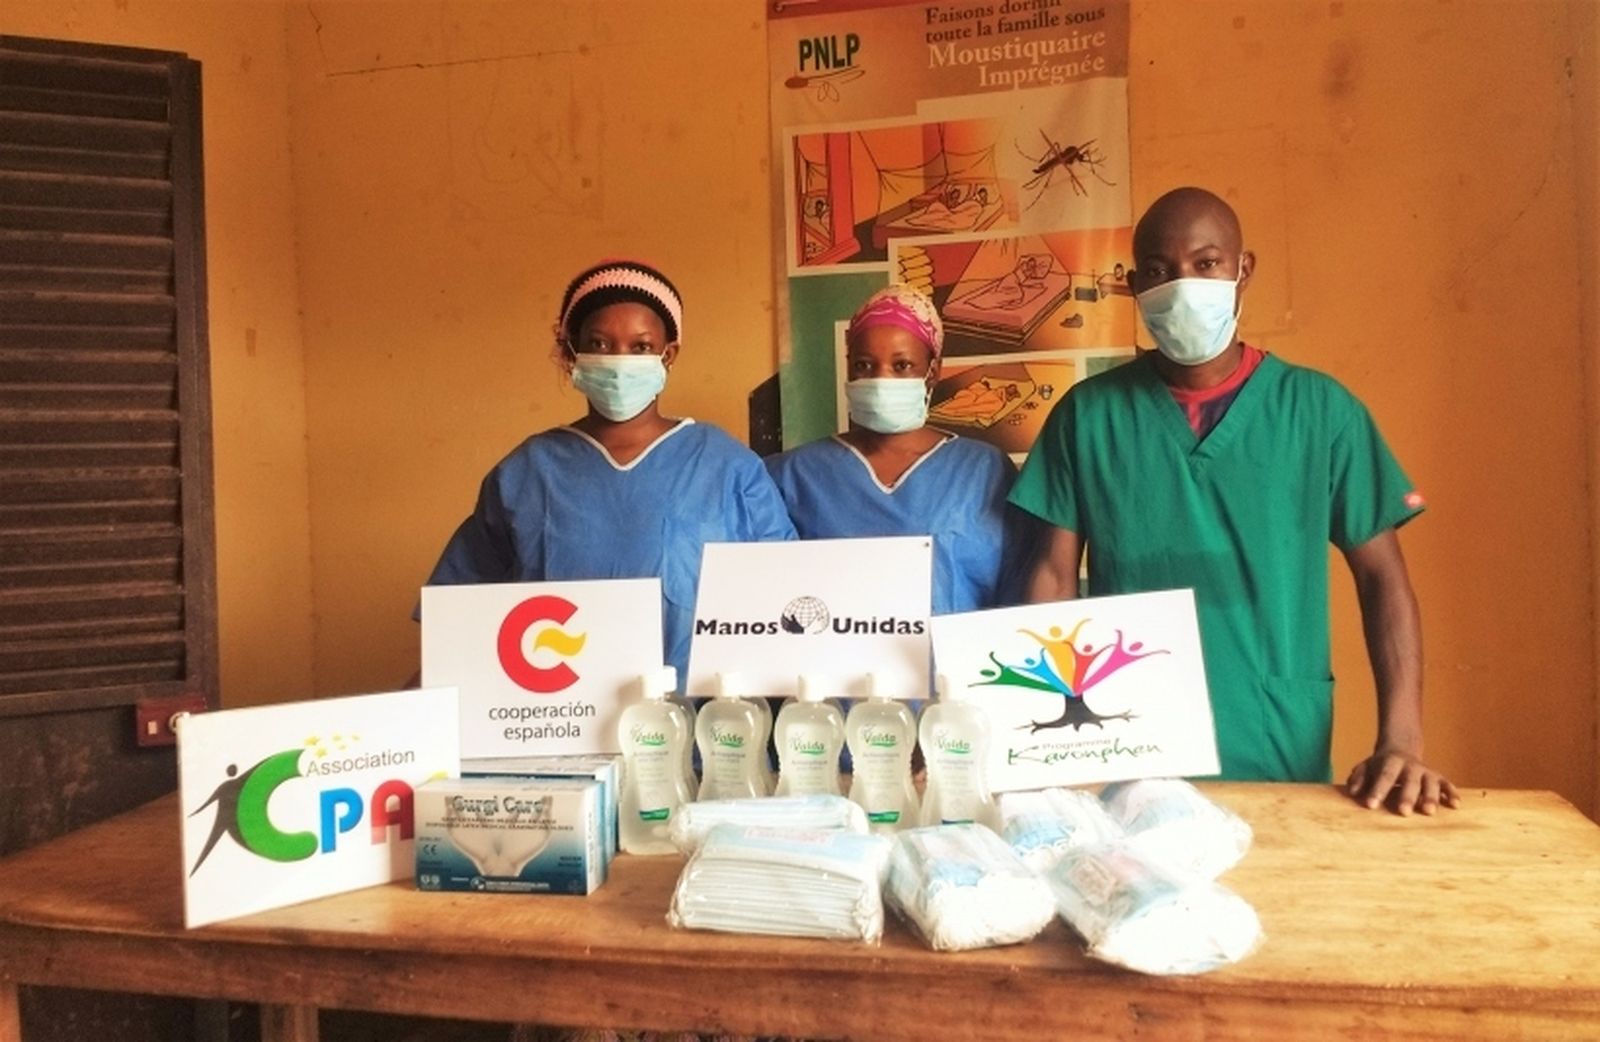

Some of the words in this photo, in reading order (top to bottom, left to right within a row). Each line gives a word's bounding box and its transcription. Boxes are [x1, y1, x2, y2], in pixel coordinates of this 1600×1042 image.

[925, 6, 994, 25] Faisons
[925, 27, 972, 43] toute
[976, 20, 993, 37] la
[997, 11, 1060, 34] famille
[1064, 8, 1106, 25] sous
[799, 33, 860, 72] PNLP
[928, 31, 1106, 69] Moustiquaire
[979, 54, 1106, 90] Imprégnée
[695, 619, 778, 636] Manos
[832, 617, 924, 635] Unidas
[488, 700, 596, 722] cooperación
[503, 721, 581, 742] española
[305, 749, 415, 777] Association
